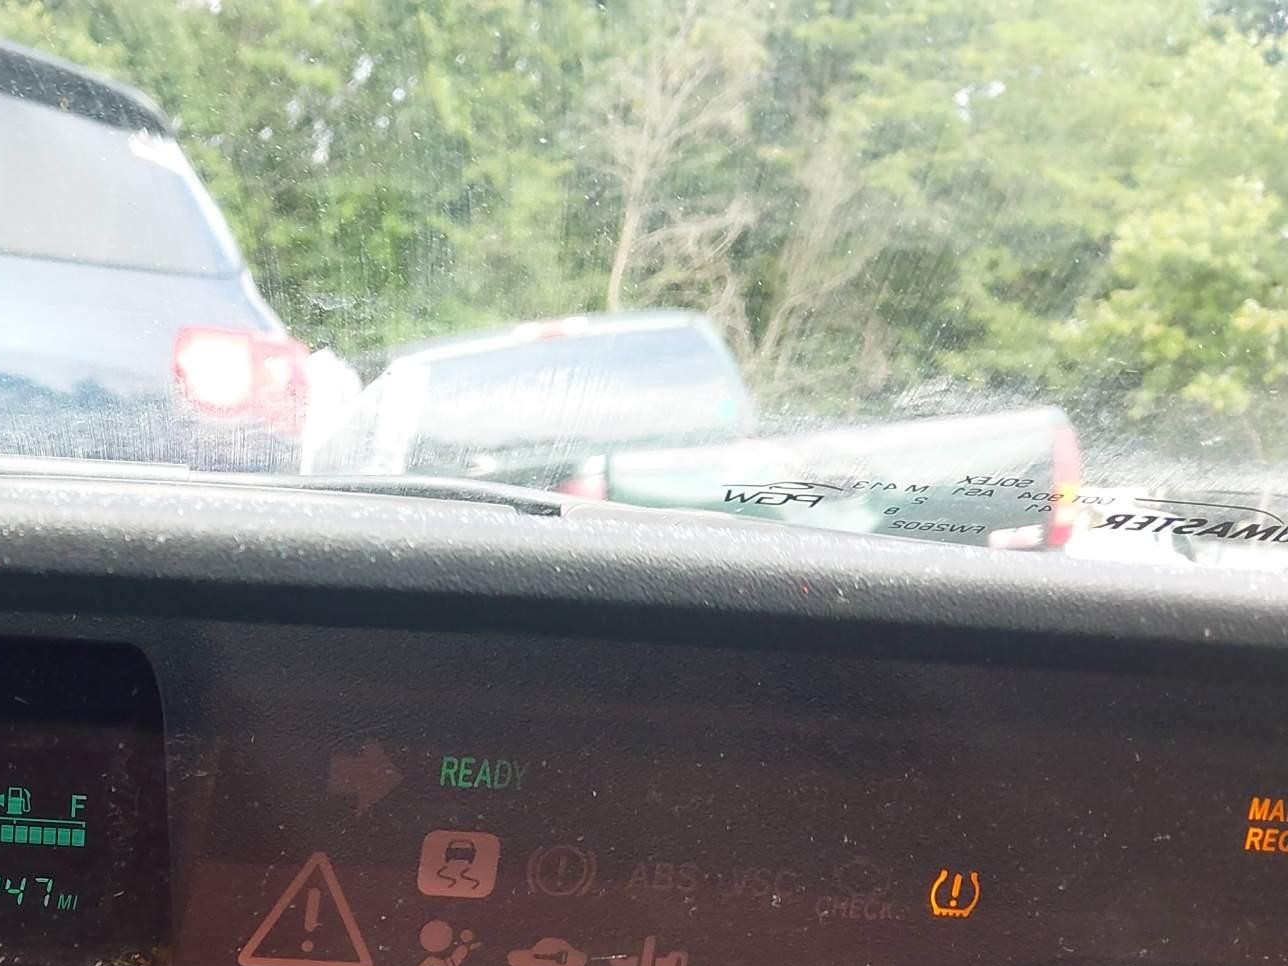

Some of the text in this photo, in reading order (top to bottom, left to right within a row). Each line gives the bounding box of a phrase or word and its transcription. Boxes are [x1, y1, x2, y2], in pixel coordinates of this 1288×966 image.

[440, 756, 530, 791] READY
[70, 794, 88, 818] F
[1248, 797, 1288, 822] MA
[626, 863, 697, 890] ABS
[57, 894, 78, 910] MI
[815, 896, 893, 920] CHECK
